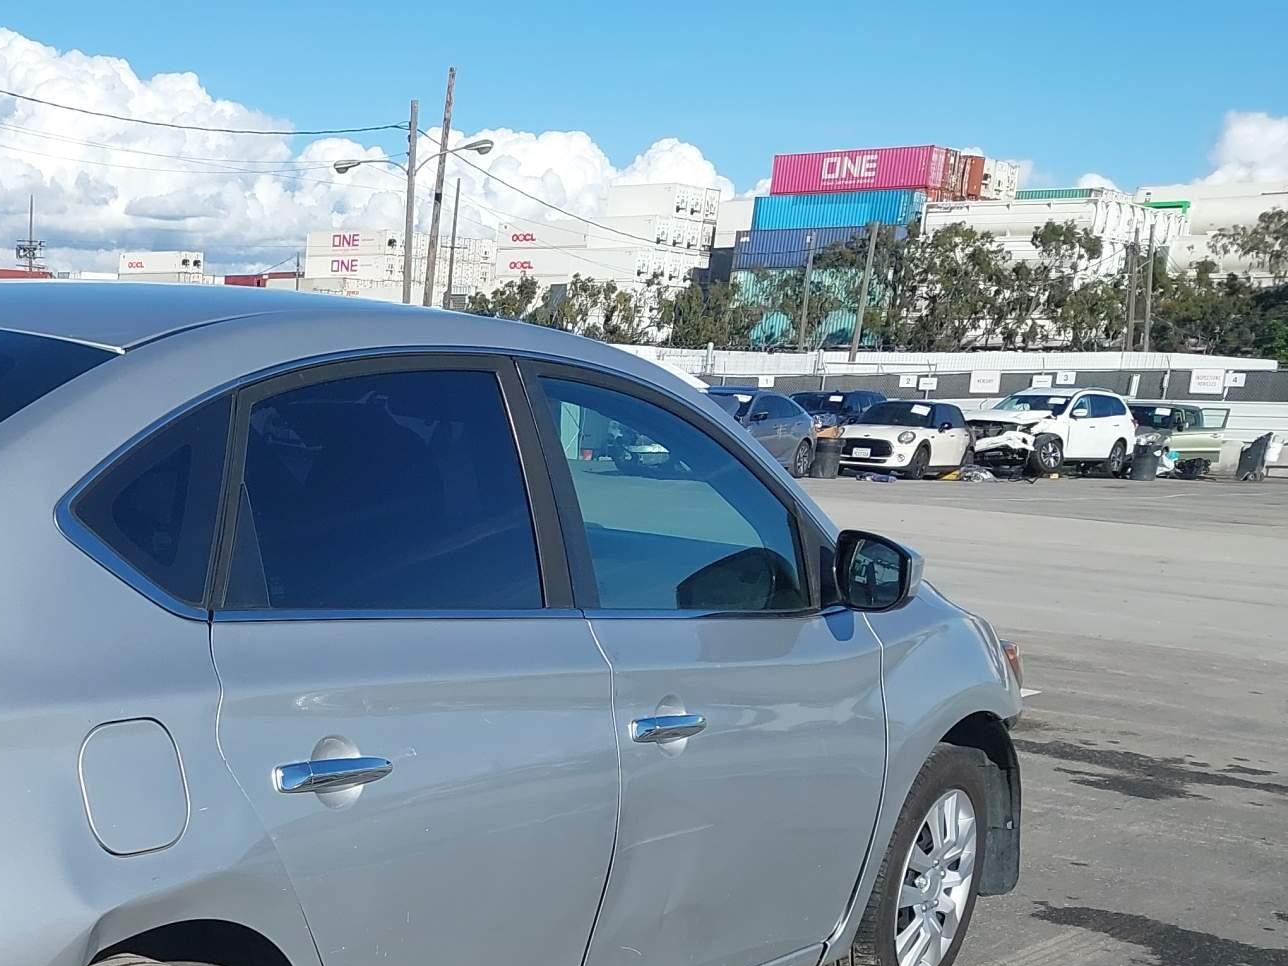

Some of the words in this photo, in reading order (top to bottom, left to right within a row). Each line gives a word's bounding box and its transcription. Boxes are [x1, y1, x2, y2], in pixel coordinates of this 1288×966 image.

[821, 154, 878, 179] ONE
[332, 233, 360, 248] ONE
[511, 232, 537, 242] OOCL
[330, 258, 358, 273] ONE
[509, 260, 534, 270] OOCL
